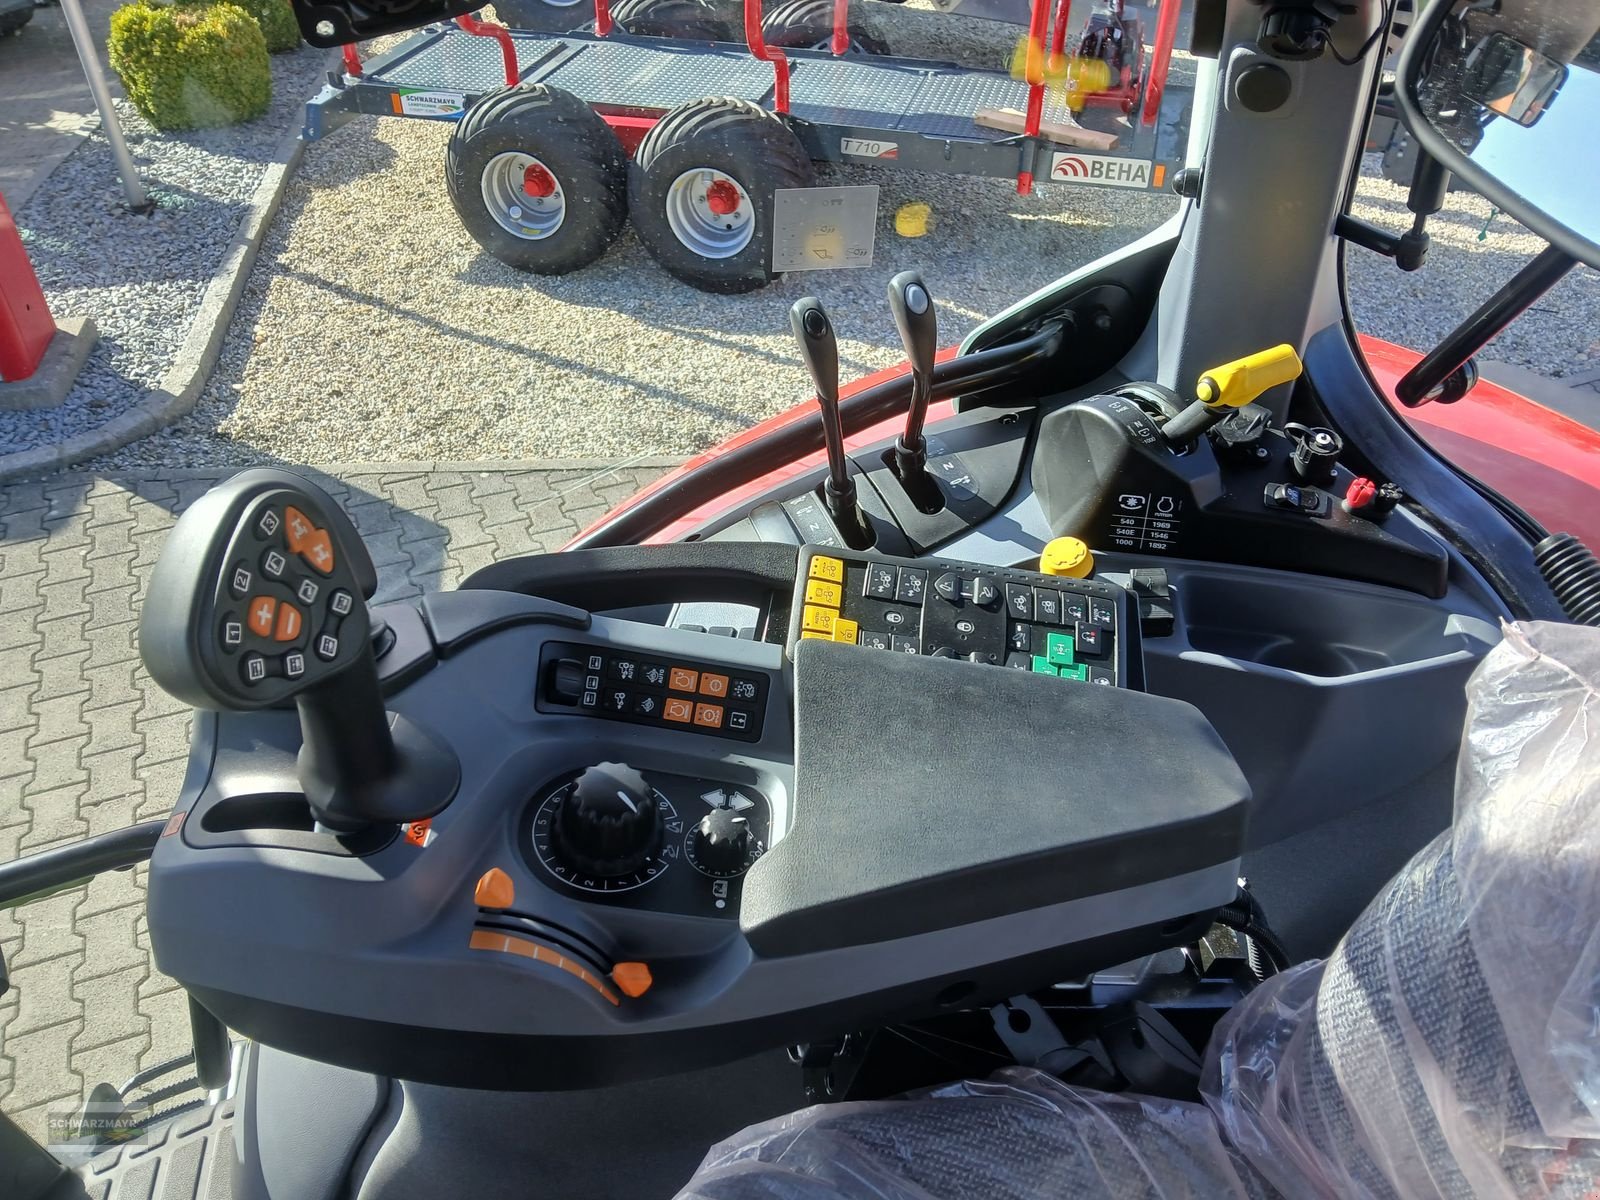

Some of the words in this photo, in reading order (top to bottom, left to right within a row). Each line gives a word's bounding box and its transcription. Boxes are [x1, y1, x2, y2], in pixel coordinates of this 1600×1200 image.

[406, 95, 456, 105] SCHWARZMAYR
[843, 139, 853, 151] T
[855, 141, 881, 154] 710
[1090, 160, 1147, 183] BEHA
[943, 461, 954, 471] N
[265, 518, 275, 530] 3
[1152, 521, 1171, 529] 1969
[1115, 528, 1136, 536] 540E
[1150, 531, 1169, 540] 1546
[1115, 538, 1134, 546] 1000
[236, 575, 247, 585] 2
[657, 668, 665, 684] AUTO
